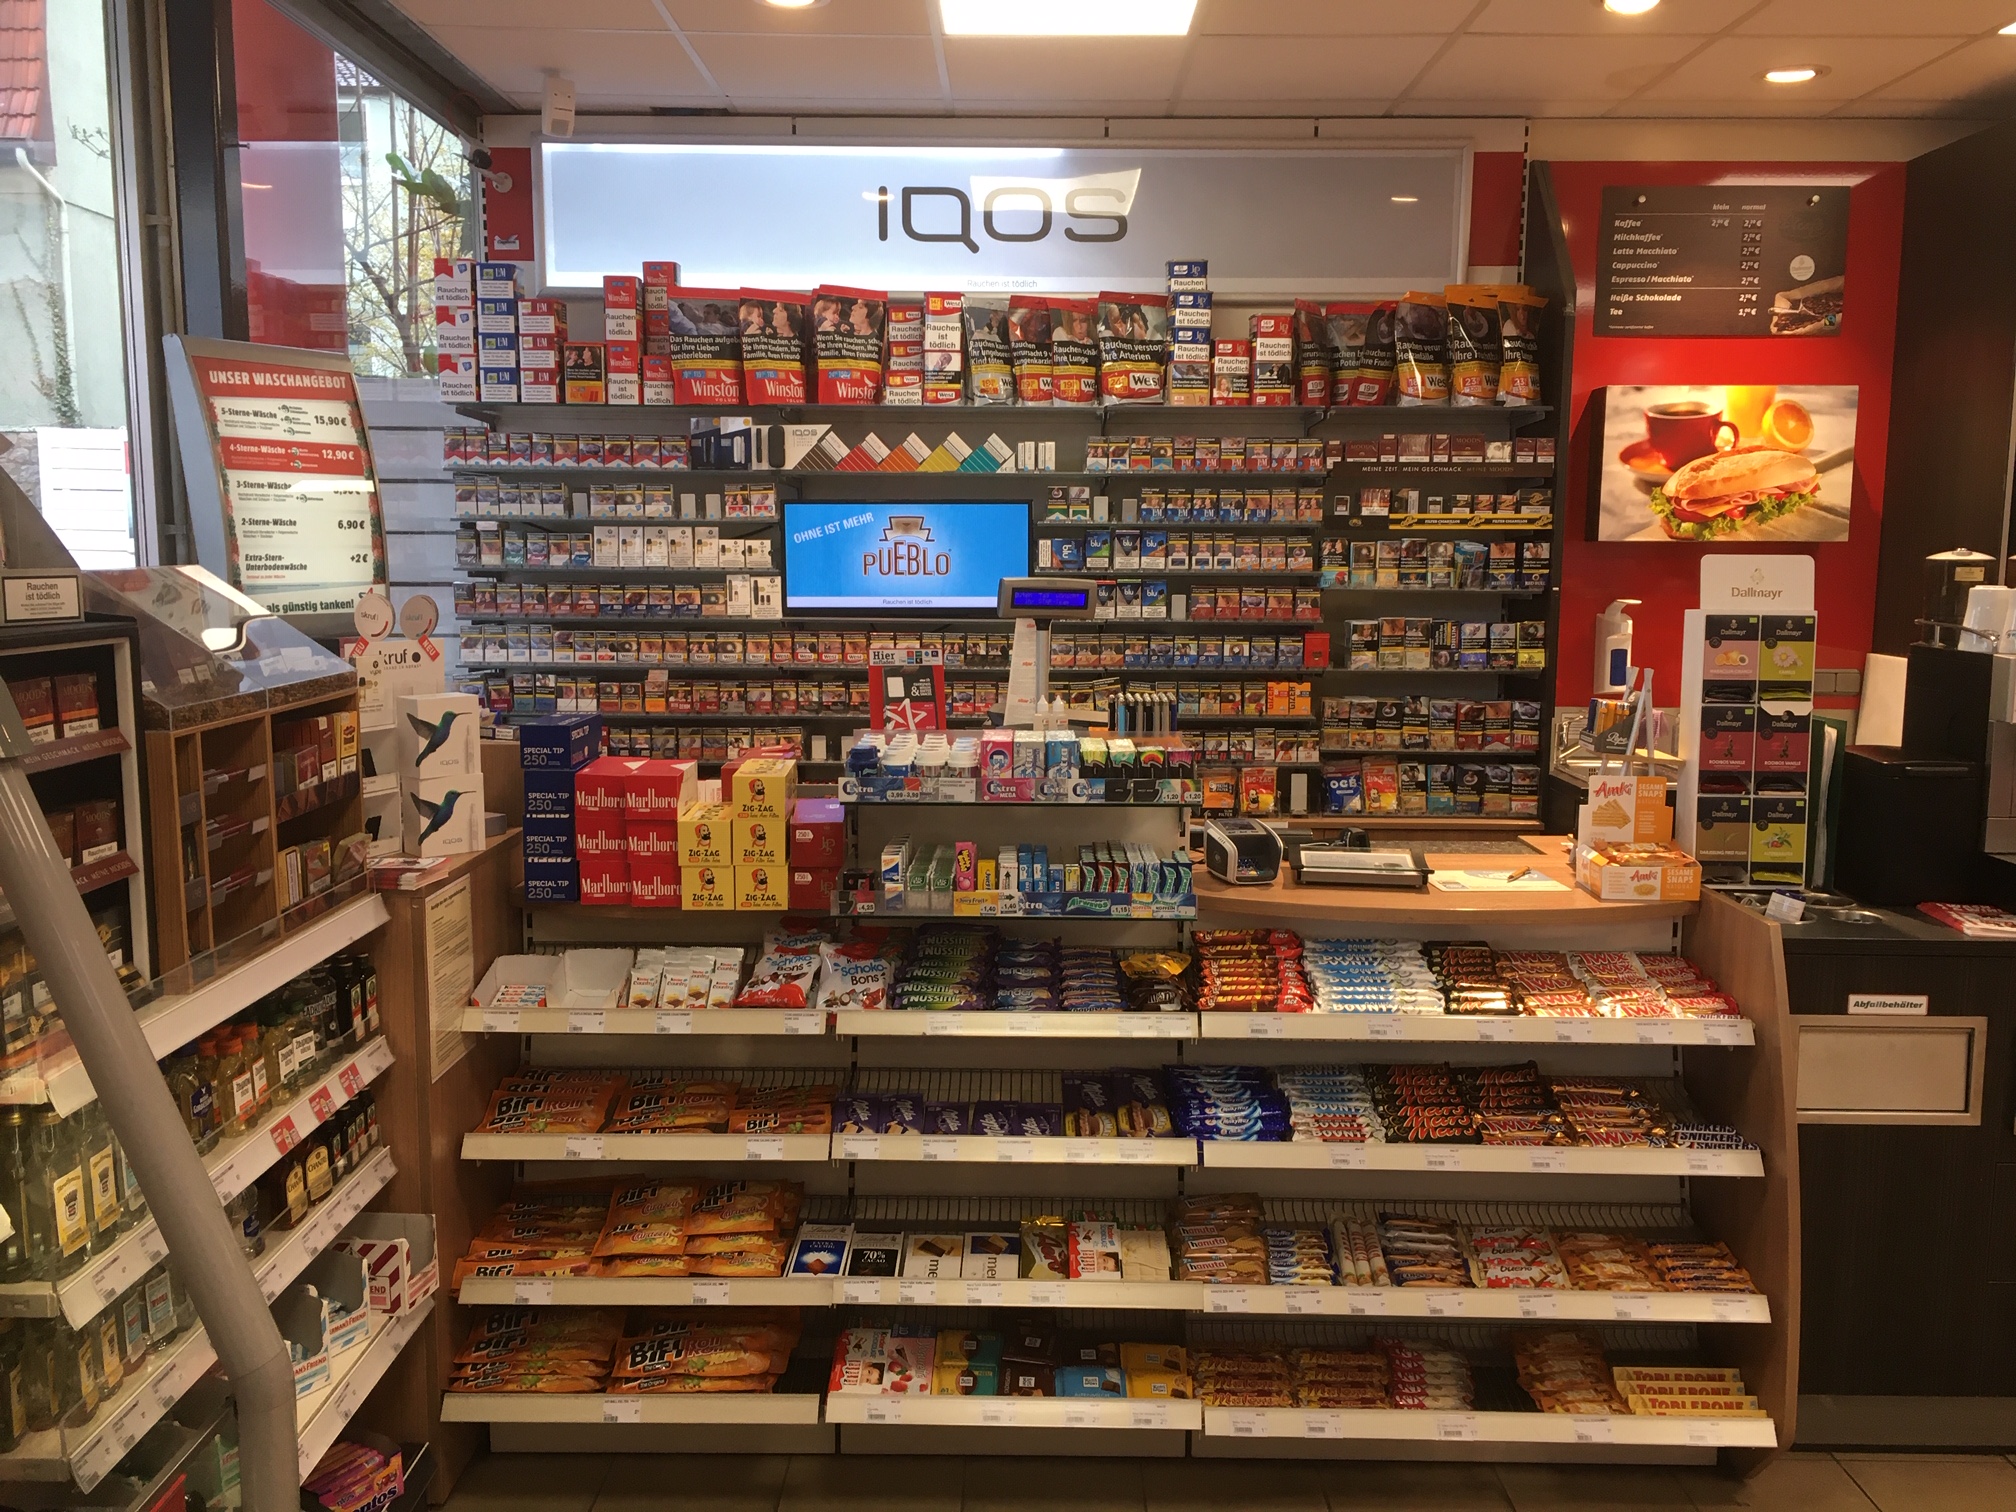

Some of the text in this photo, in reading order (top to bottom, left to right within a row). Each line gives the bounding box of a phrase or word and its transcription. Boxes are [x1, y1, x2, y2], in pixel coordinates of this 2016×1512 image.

[968, 279, 1038, 288] Rauchen ist tödlich
[1610, 294, 1682, 302] Heiße Schokolade
[926, 324, 960, 332] Rauchen
[670, 344, 680, 352] für
[930, 341, 956, 349] tödlich
[672, 351, 712, 359] weiterleben
[1054, 354, 1089, 364] Ihre Lunge
[972, 357, 988, 365] Kind
[209, 370, 346, 388] UNSER WASCHANGEBOT
[1133, 374, 1160, 388] West
[690, 380, 740, 397] Winston
[764, 379, 804, 398] Winston
[221, 407, 278, 420] 5-Sterne-Wäsche
[314, 415, 348, 426] 15,90 €
[230, 444, 286, 454] 4-Sterne-Wäsche
[322, 449, 354, 460] 12,90 €
[241, 518, 298, 527] 2-Sterne-Wäsche
[338, 520, 366, 530] 6,90 €
[794, 512, 874, 544] OHNE IST MEHR
[1090, 540, 1101, 548] blu
[1122, 538, 1134, 548] blu
[245, 554, 285, 562] Extra-Stern-
[350, 554, 368, 563] +2 €
[862, 540, 952, 577] PUEBLO
[246, 563, 308, 571] Unterbodenwäsche
[26, 582, 59, 591] Rauchen
[26, 591, 60, 600] ist tödlich
[1732, 587, 1783, 600] Dallmayr
[266, 599, 354, 614] als günstig tanken!
[422, 641, 436, 656] NEU
[872, 651, 896, 660] Hier
[24, 754, 41, 765] MEIN
[42, 746, 80, 761] GESCHMACK
[524, 755, 547, 766] 250
[1330, 779, 1358, 789] OCB
[1594, 780, 1634, 798] Amki
[576, 787, 626, 808] Marlboro
[626, 788, 677, 809] Marlboro
[528, 800, 552, 810] 250
[742, 804, 774, 812] ZIG-ZAG
[577, 830, 627, 851] Marlboro
[628, 832, 678, 852] Marlboro
[526, 844, 550, 854] 250
[1630, 870, 1658, 882] Amki
[1666, 876, 1694, 884] SNAPS
[582, 874, 632, 894] Marlboro
[528, 888, 552, 898] 250
[1504, 952, 1550, 964] TWIX
[1579, 952, 1630, 964] TWIX
[776, 963, 804, 972] Bons
[851, 974, 880, 986] Bons
[1333, 1004, 1398, 1012] BOUNTY
[1853, 1000, 1924, 1009] Abfallbehälter
[1478, 1068, 1536, 1084] Mars
[1486, 1120, 1540, 1133] TWIX
[1674, 1122, 1736, 1133] SNICKERS
[1318, 1130, 1371, 1138] BOUNTY
[1409, 1127, 1475, 1140] Mars
[1680, 1132, 1744, 1143] SNICKERS
[1181, 1226, 1218, 1236] hanuta
[1484, 1226, 1516, 1234] bueno
[1188, 1238, 1228, 1249] hanuta
[863, 1250, 886, 1259] 70%
[1188, 1260, 1228, 1271] hanuta
[349, 1310, 366, 1325] FRIEND
[306, 1356, 327, 1370] FRIEND
[1633, 1370, 1726, 1382] TOBLERONE
[1636, 1384, 1731, 1396] TOBLERONE
[1650, 1398, 1744, 1410] TOBLERONE
